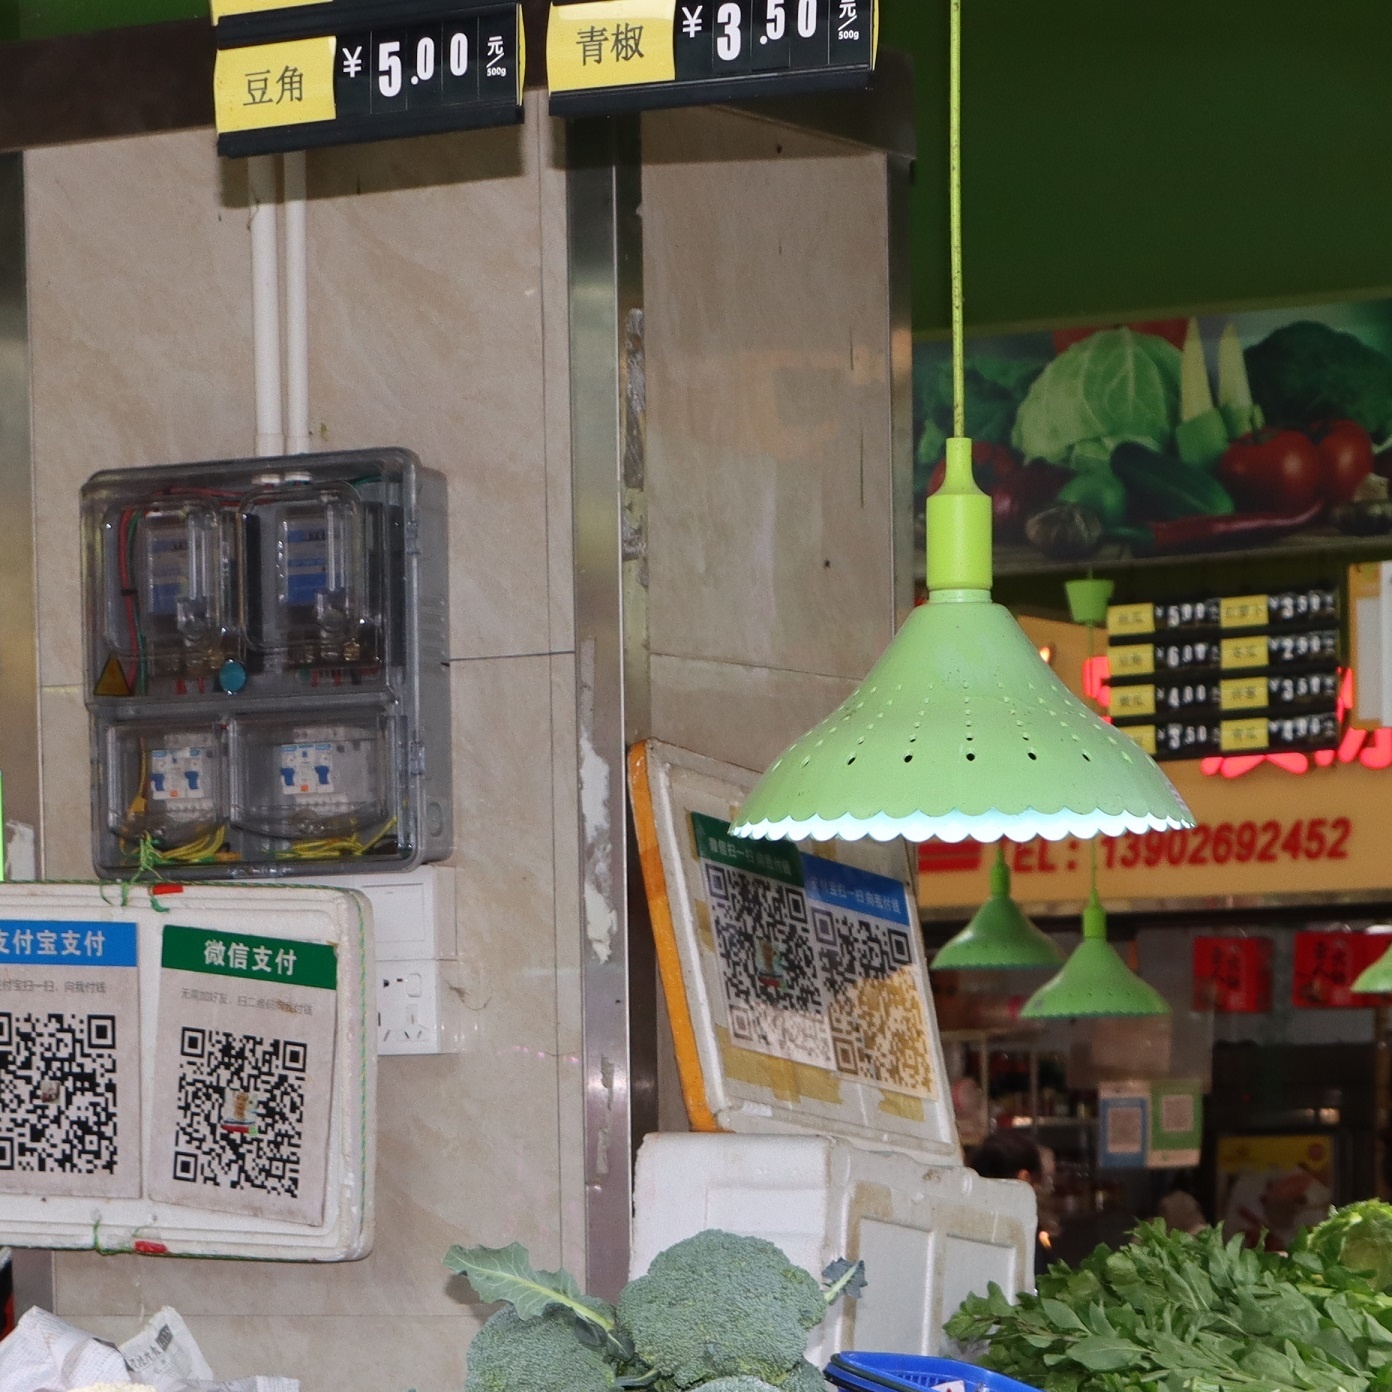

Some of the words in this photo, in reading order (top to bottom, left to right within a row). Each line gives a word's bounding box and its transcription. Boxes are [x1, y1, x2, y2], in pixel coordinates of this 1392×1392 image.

[576, 22, 644, 66] 青椒
[242, 65, 304, 107] 豆角
[204, 939, 297, 976] 微信支付
